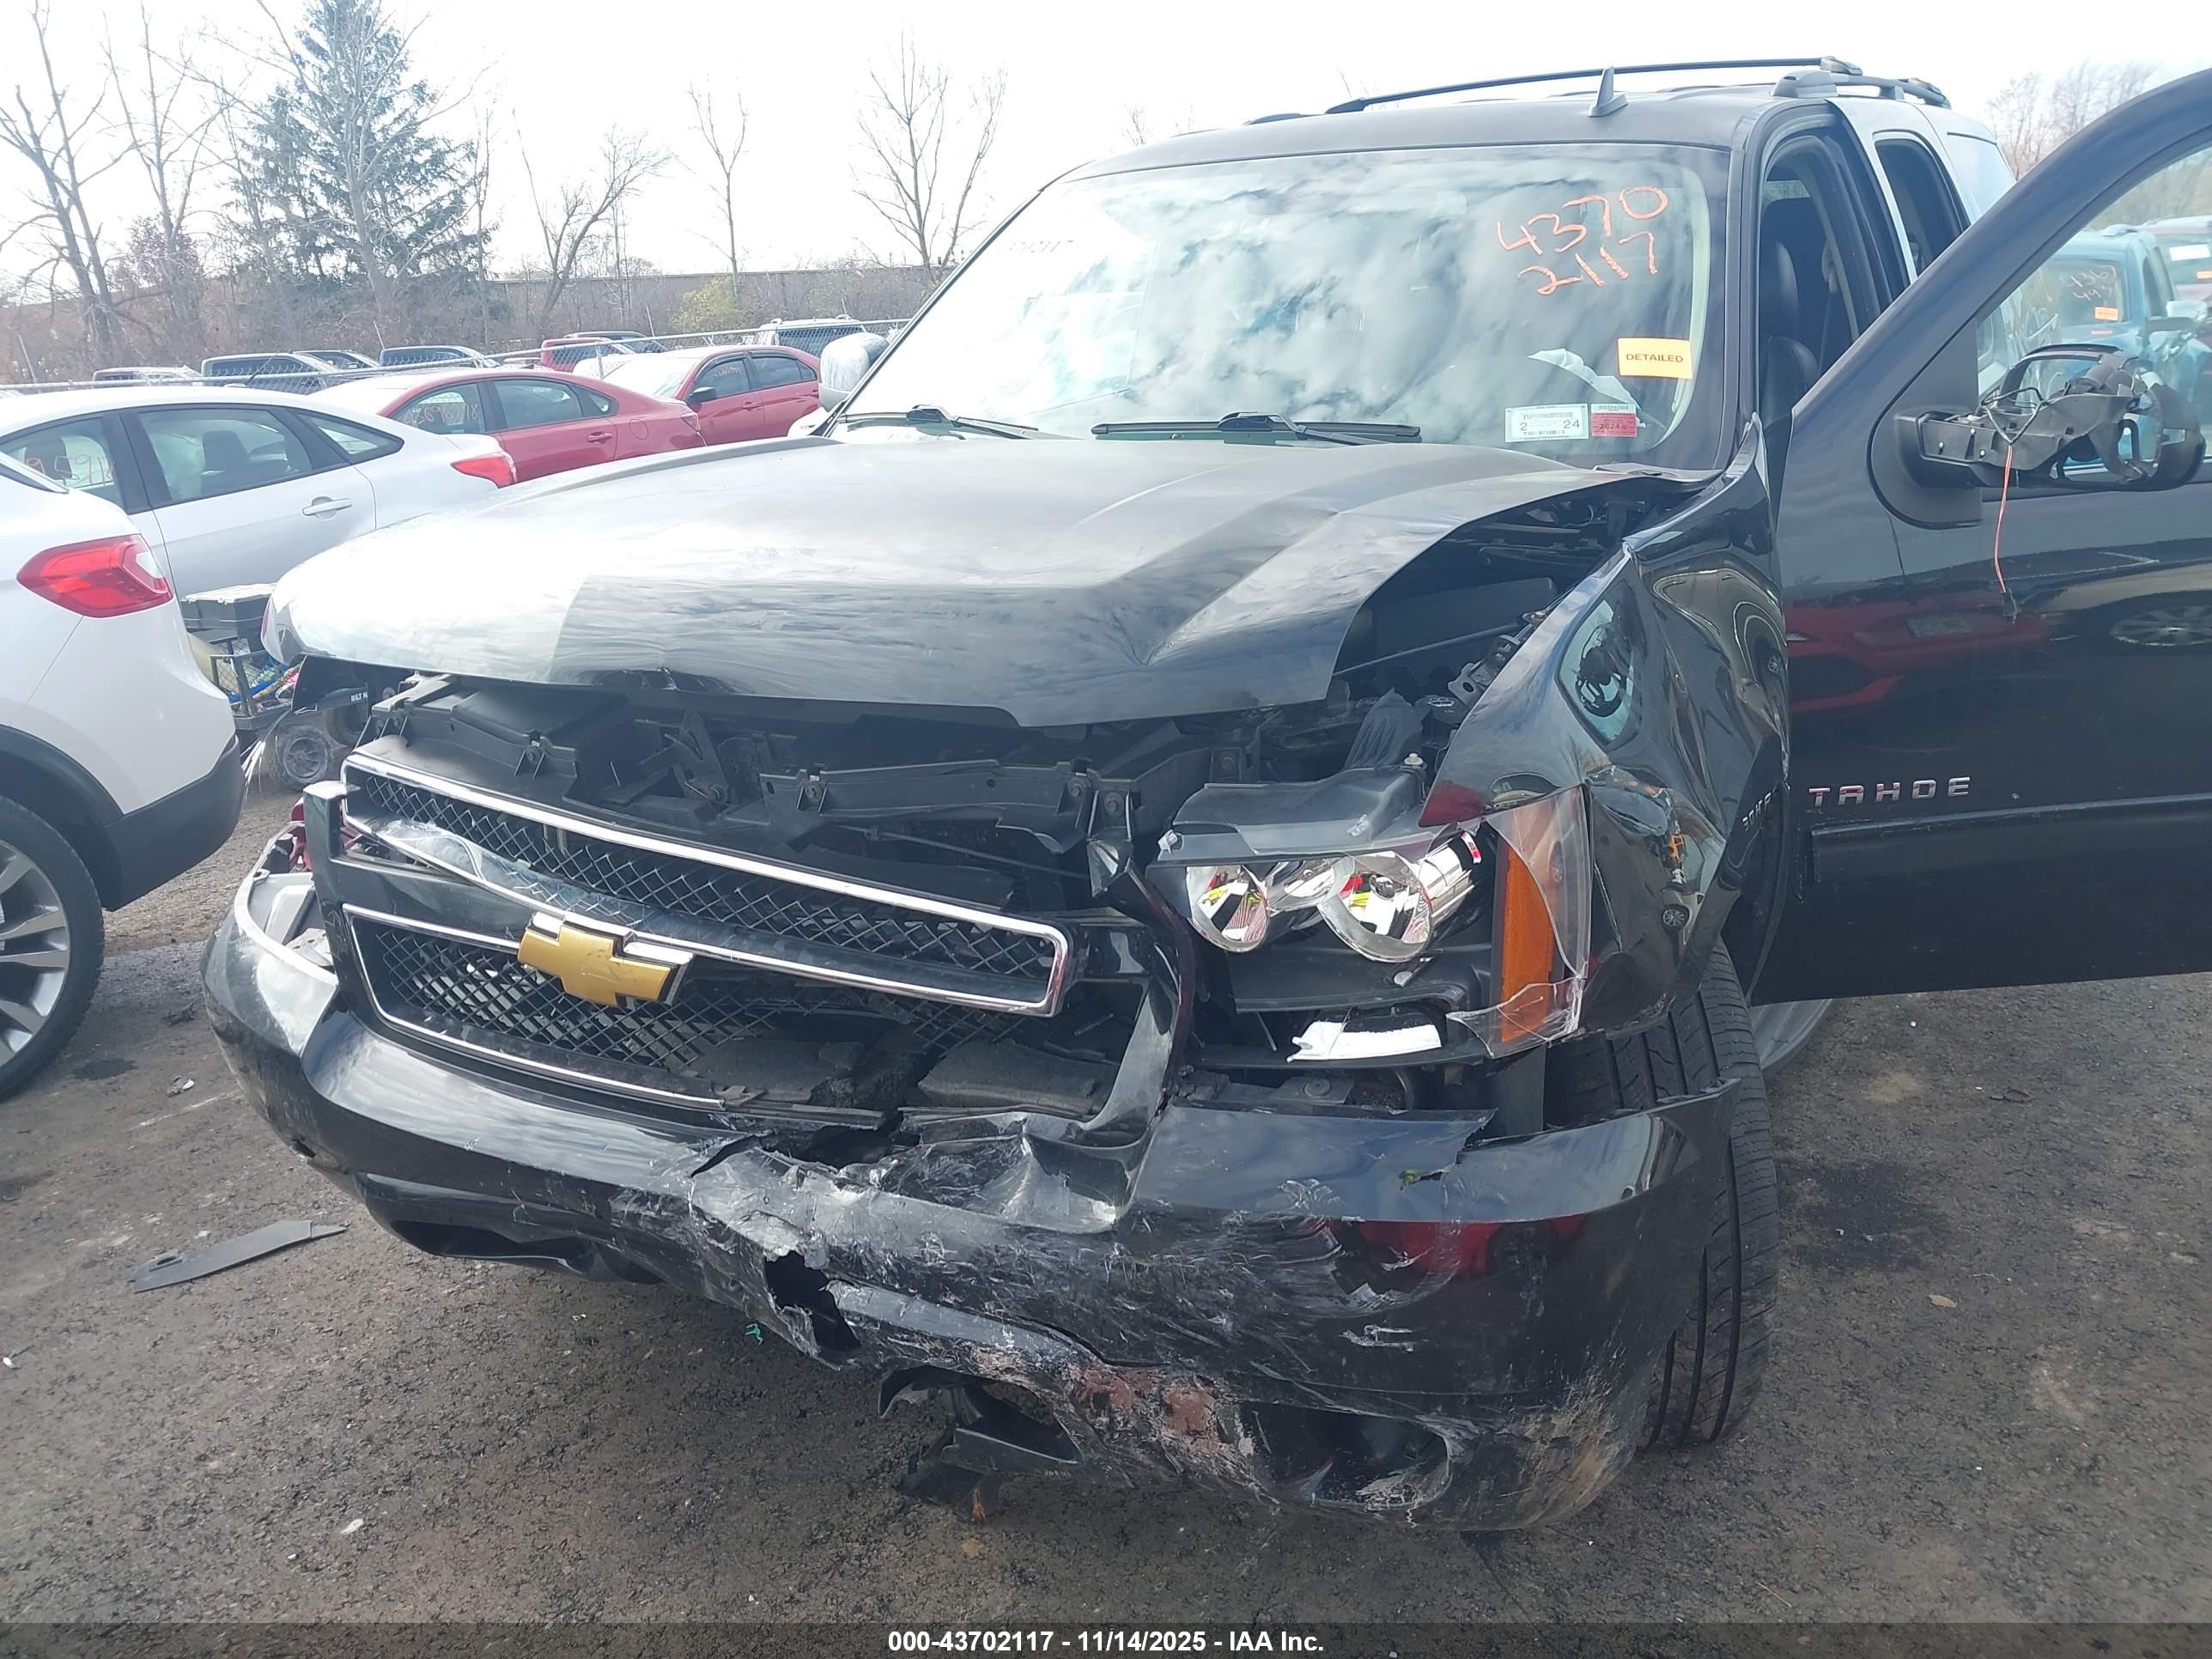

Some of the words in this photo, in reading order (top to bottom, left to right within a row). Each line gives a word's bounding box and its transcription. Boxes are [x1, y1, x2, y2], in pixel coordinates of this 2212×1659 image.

[1497, 185, 1668, 256] 4370
[1517, 231, 1658, 295] 2117
[1626, 353, 1684, 362] DETAILED
[1563, 419, 1580, 429] 24
[1808, 776, 1971, 807] TAHOE
